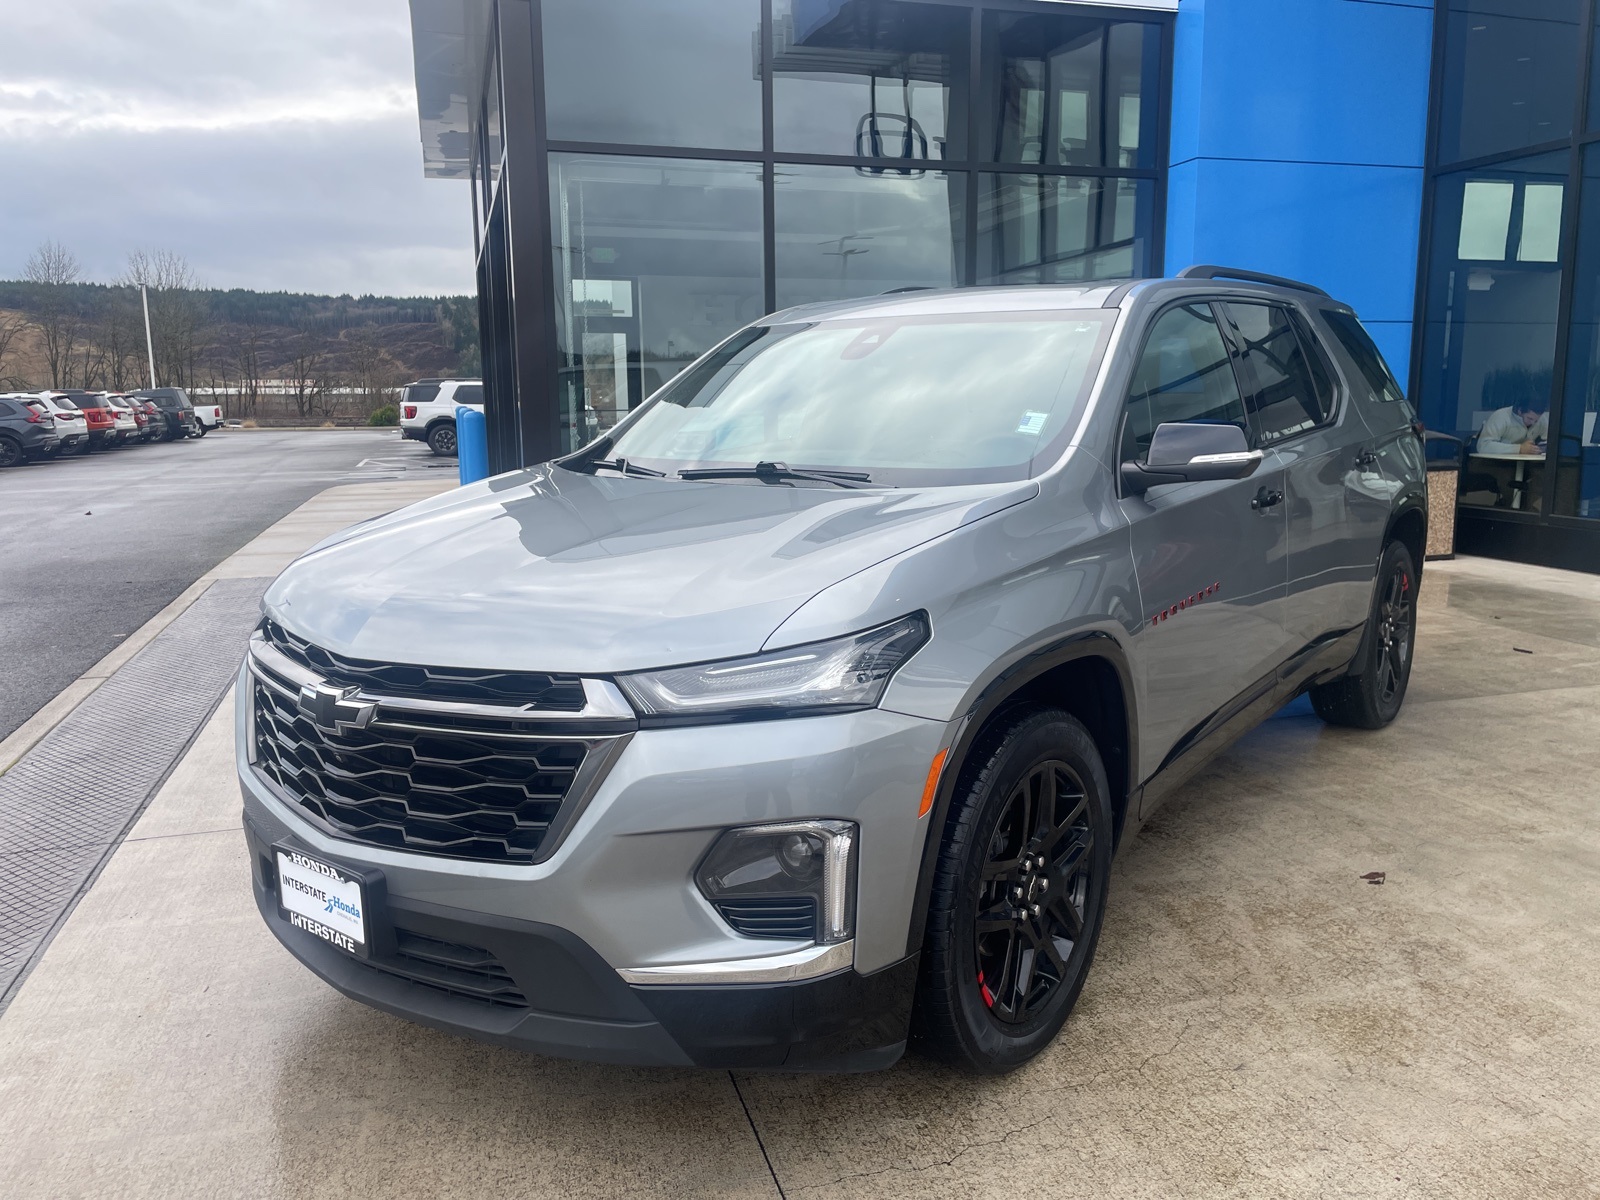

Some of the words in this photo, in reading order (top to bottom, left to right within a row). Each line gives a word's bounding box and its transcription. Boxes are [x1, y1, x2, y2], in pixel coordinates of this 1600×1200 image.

[1152, 581, 1221, 626] TRAVERSE
[291, 852, 339, 880] HONDA
[282, 874, 327, 903] INTERSTATE
[332, 896, 360, 919] Honda
[290, 912, 355, 953] INTERSTATE
